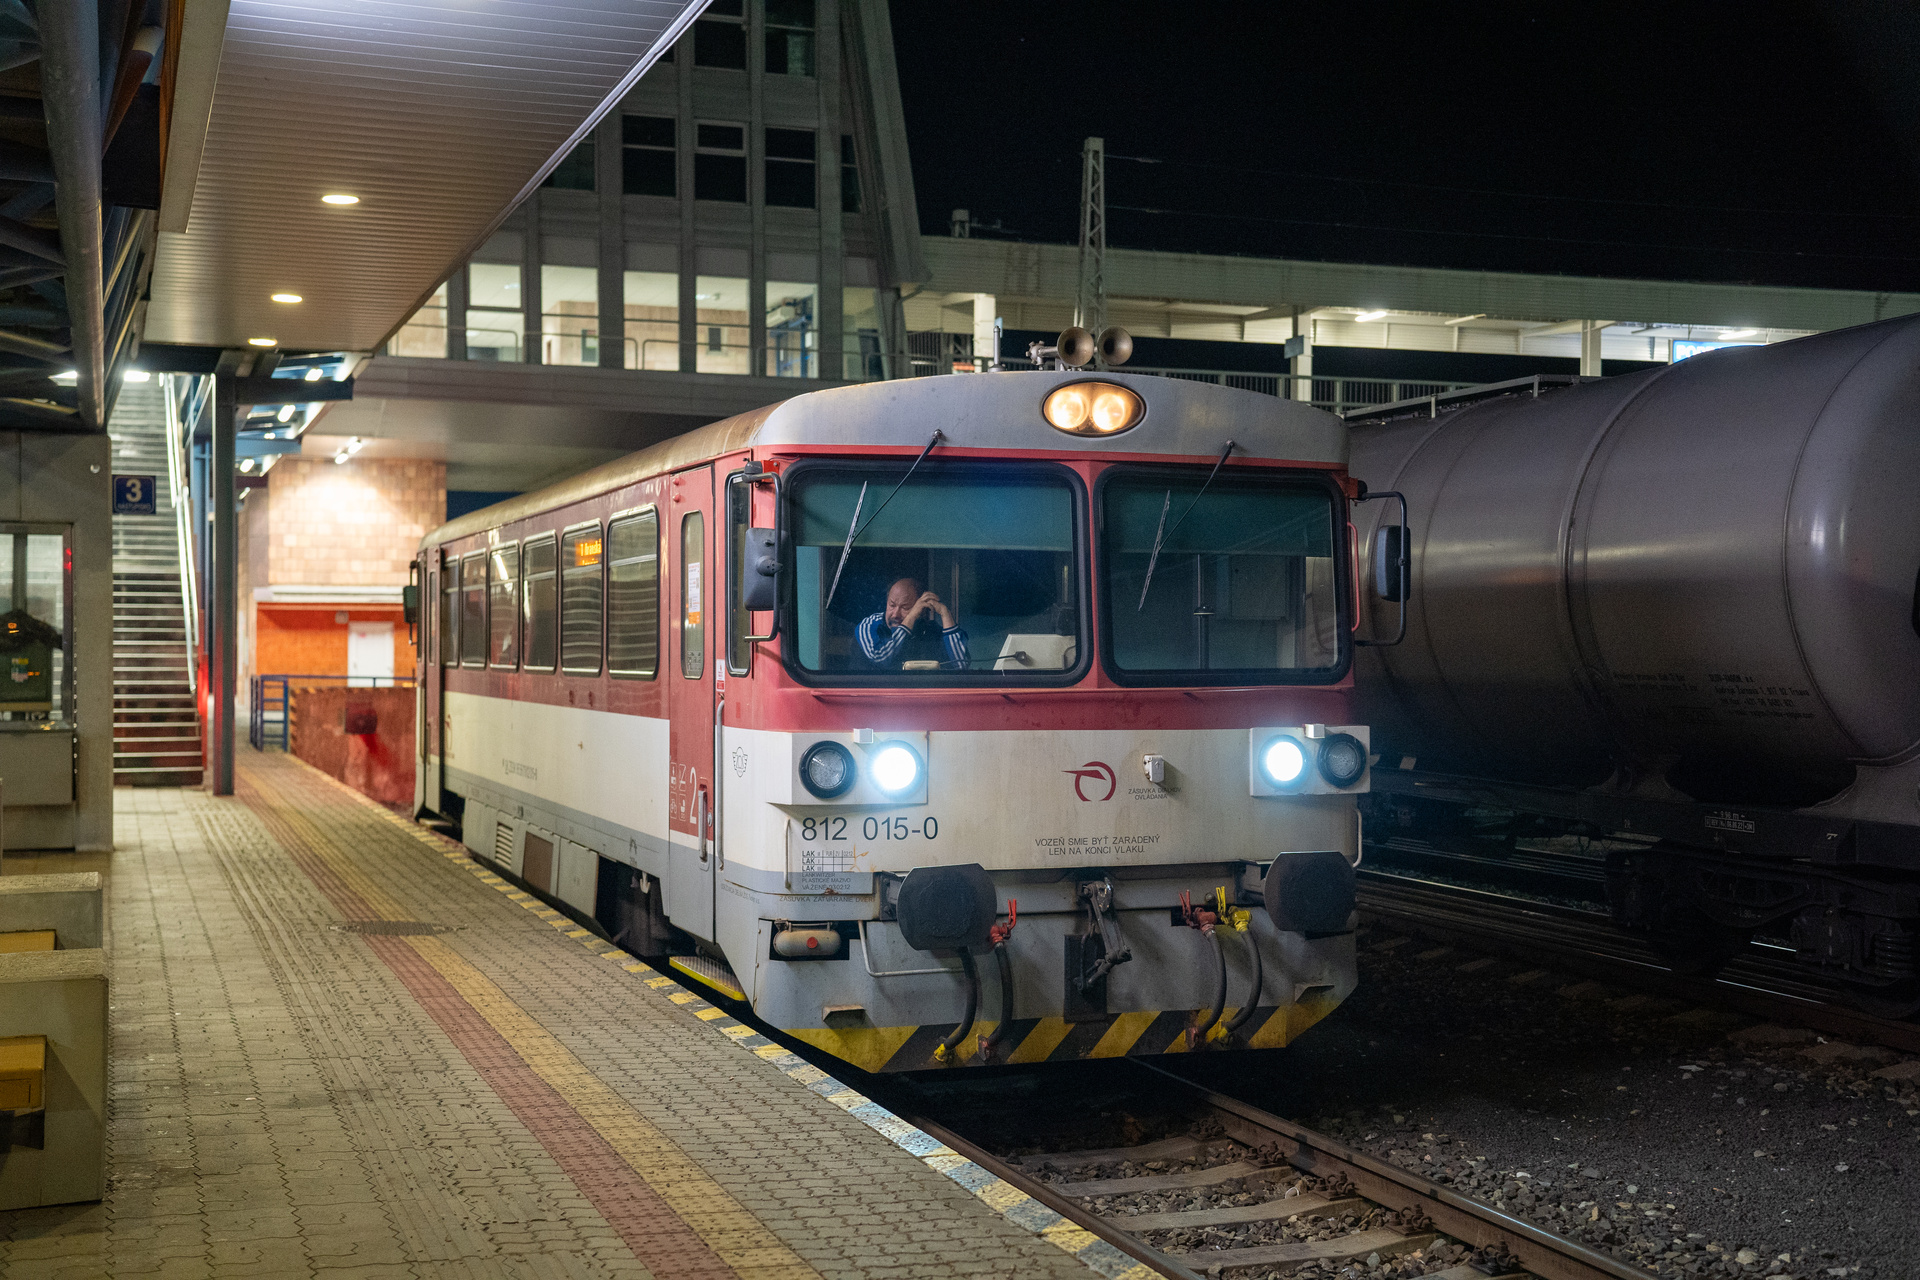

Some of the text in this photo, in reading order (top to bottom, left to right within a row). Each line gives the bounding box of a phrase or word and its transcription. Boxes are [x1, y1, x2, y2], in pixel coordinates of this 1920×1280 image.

[126, 478, 142, 503] 3
[690, 767, 697, 824] 2
[802, 816, 938, 841] 812 015-0
[1035, 834, 1160, 846] VOZEŇ SMIE BYŤ ZARADENÝ
[1049, 847, 1066, 855] LEN
[1069, 846, 1081, 855] NA
[1085, 846, 1111, 854] KONCI
